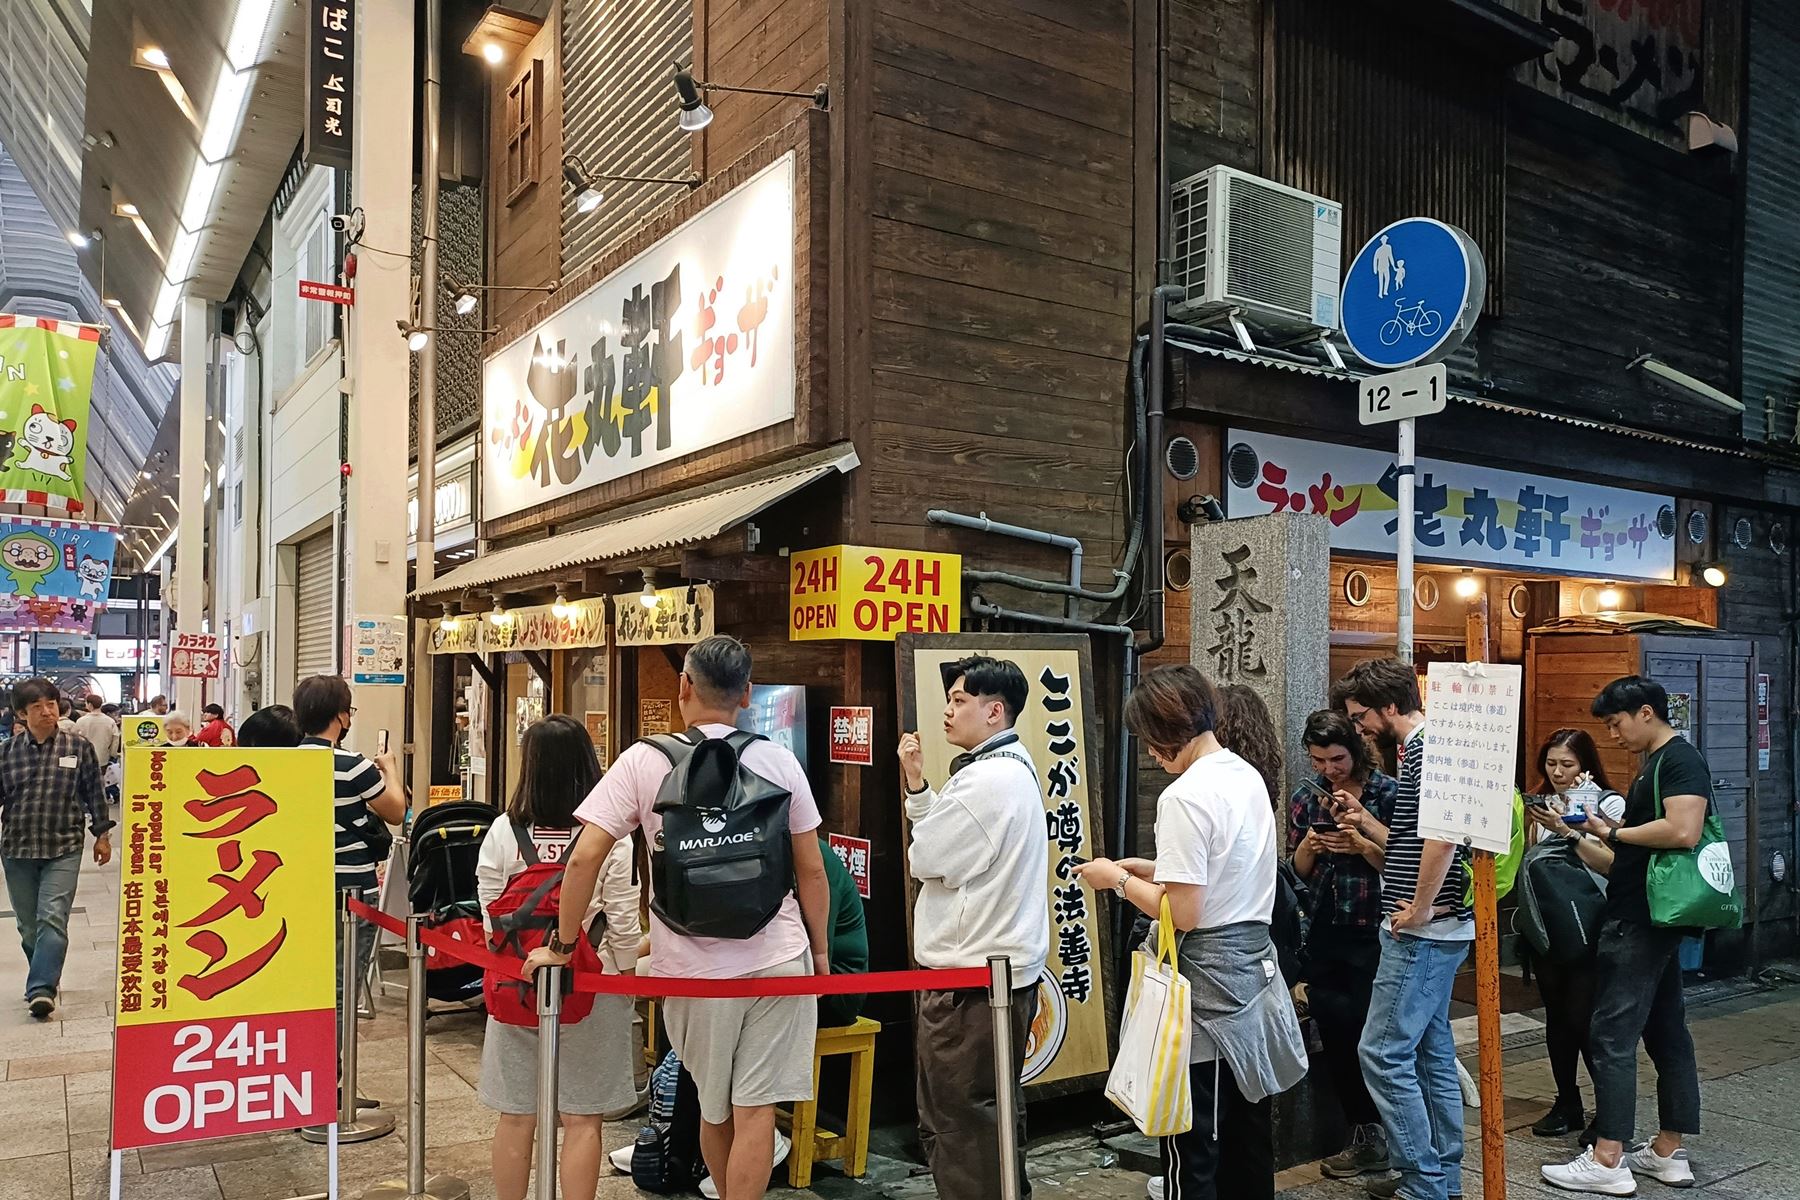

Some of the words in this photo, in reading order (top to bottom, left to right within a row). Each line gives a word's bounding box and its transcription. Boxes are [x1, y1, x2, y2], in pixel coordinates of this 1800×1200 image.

[322, 0, 348, 60] ばこ
[527, 262, 683, 487] 花丸軒
[1257, 460, 1362, 527] ラーメン
[794, 556, 838, 595] 24H
[863, 555, 941, 596] 24H
[793, 603, 837, 630] OPEN
[853, 598, 949, 633] OPEN
[1206, 543, 1273, 681] 天龍
[178, 633, 217, 648] カラオケ
[833, 716, 869, 745] 禁煙
[1429, 718, 1512, 734] ですからみなさんのご
[150, 751, 167, 791] Most
[131, 794, 149, 812] in
[129, 823, 148, 875] Japan
[147, 801, 166, 874] popular
[680, 832, 754, 851] MARJAQE
[1039, 666, 1091, 1004] ここが噂の法善寺
[174, 764, 288, 1002] ラーメン
[152, 878, 170, 939] 일본에서
[120, 880, 145, 1013] 在日本最受欢迎
[151, 943, 170, 975] 가장
[150, 978, 168, 1010] 인기
[172, 1021, 287, 1073] 24H
[143, 1071, 313, 1134] OPEN
